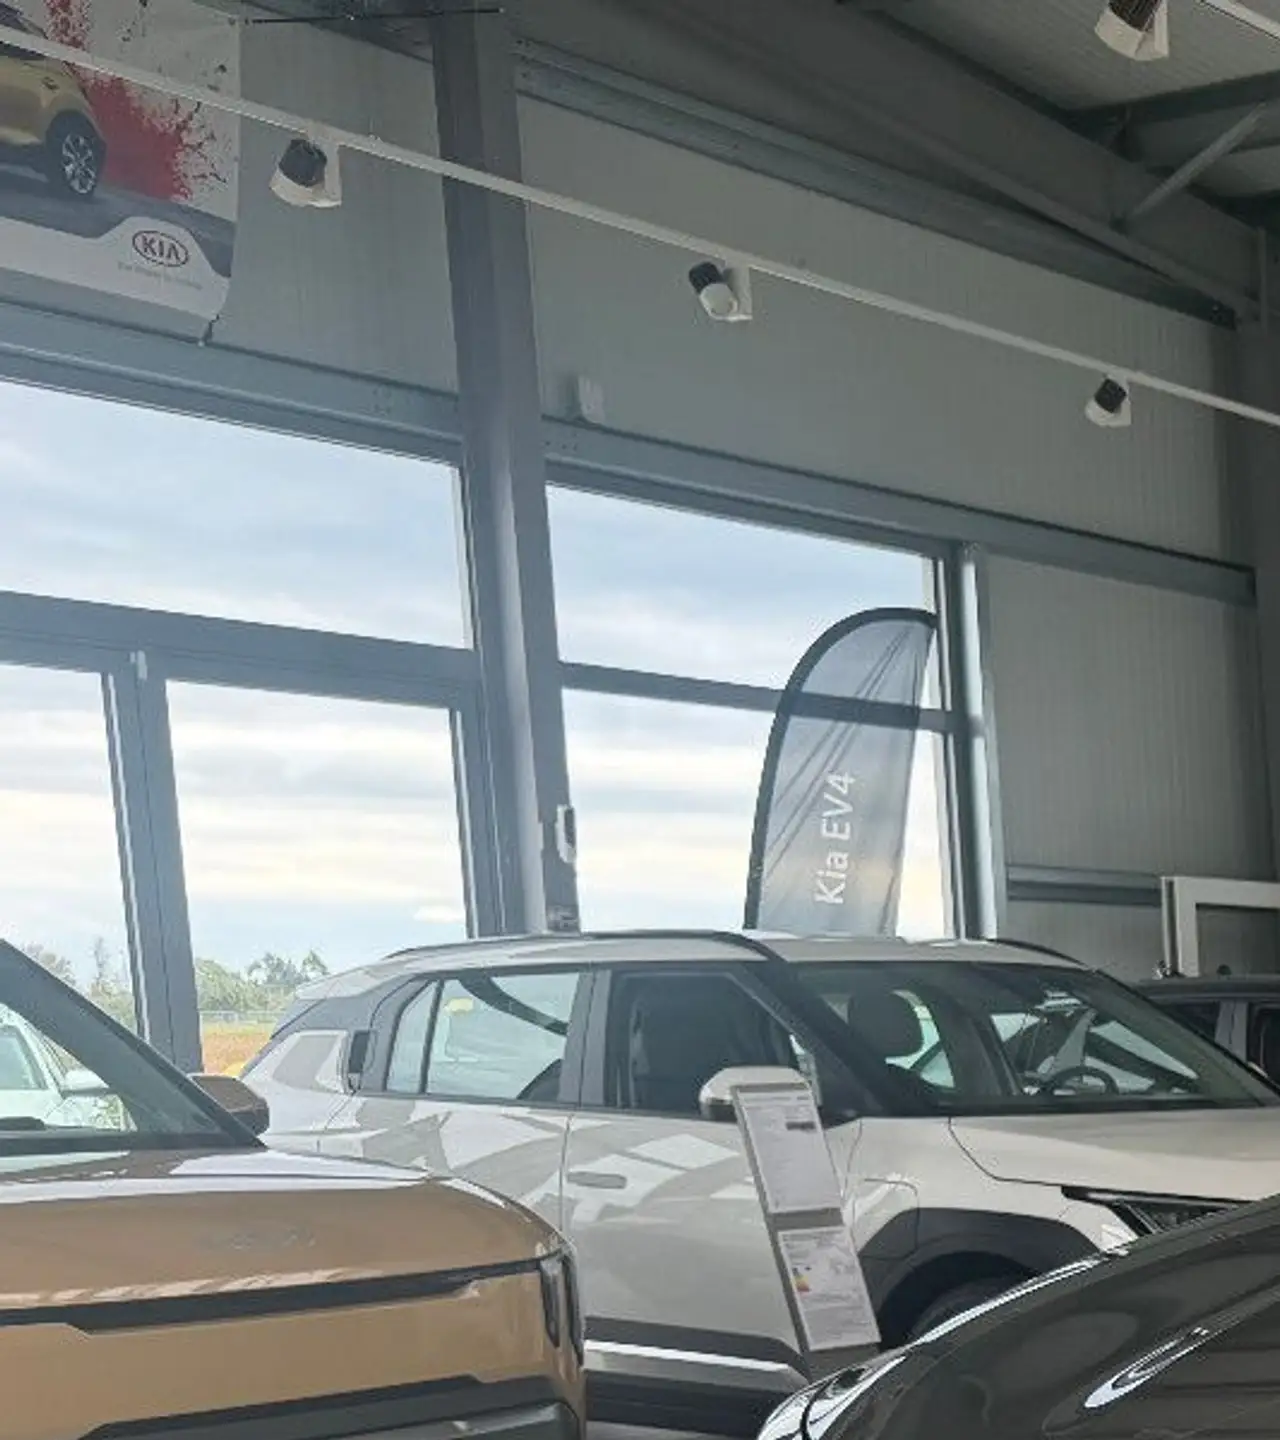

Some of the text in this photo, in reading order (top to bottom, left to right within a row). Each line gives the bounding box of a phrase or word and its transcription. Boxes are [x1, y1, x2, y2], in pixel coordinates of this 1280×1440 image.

[141, 235, 182, 262] KIA
[815, 771, 856, 905] Kia EV4
